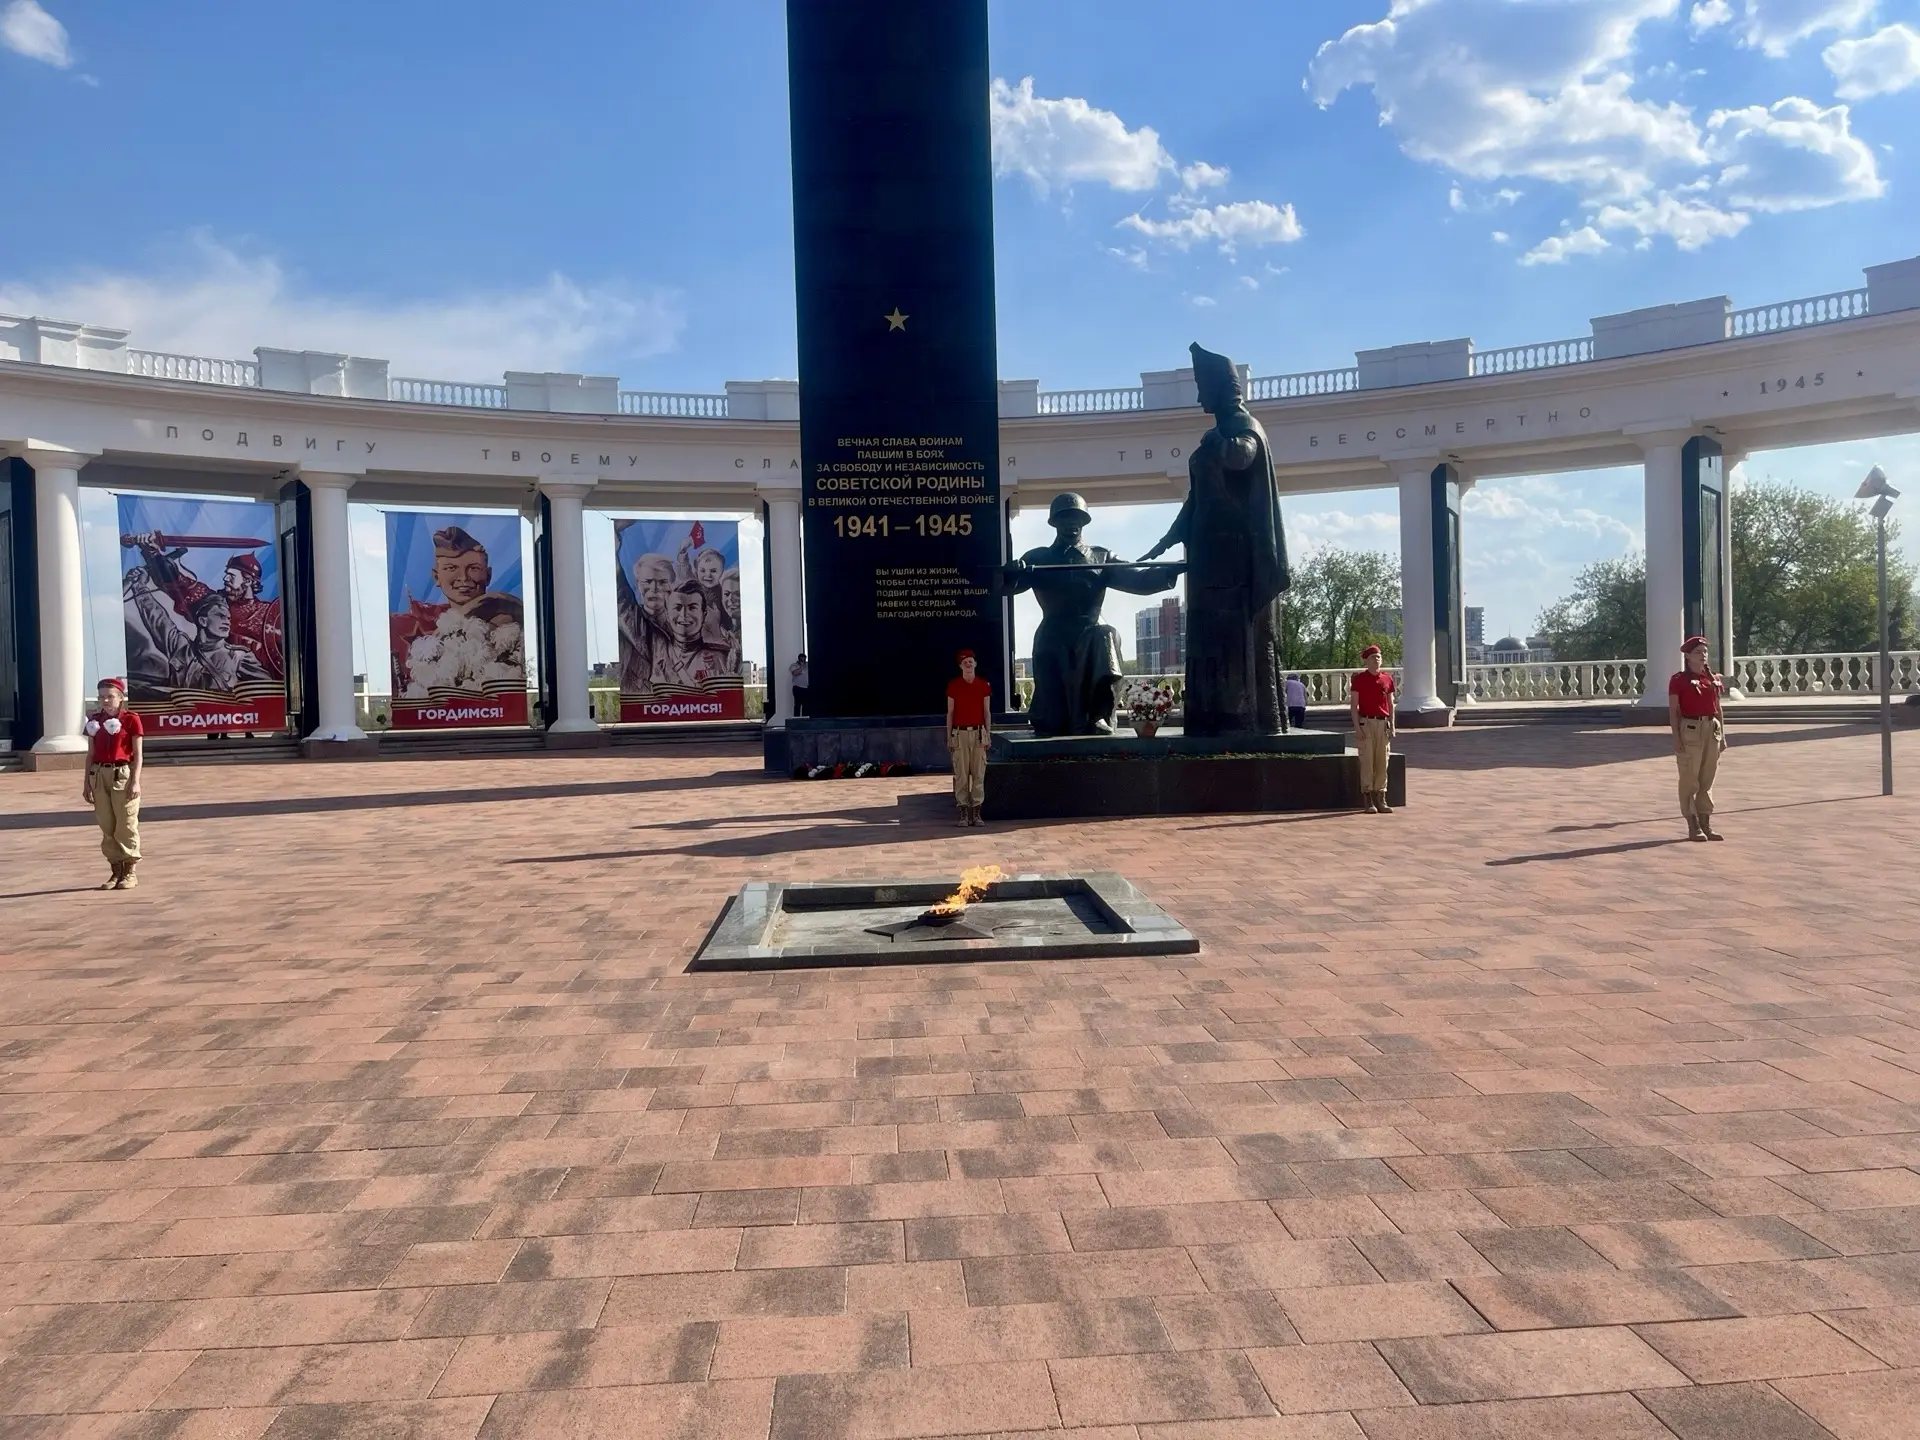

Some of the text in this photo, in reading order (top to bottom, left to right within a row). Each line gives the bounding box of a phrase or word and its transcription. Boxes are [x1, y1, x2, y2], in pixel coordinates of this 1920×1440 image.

[1759, 372, 1825, 395] 1945
[166, 407, 1591, 470] ПОДВИГУ ТВОЕМУ СЛА ТВО БЕССМЕРТНО
[837, 437, 963, 447] ВЕЧНАЯ СЛАВА ВОИНАМ
[857, 450, 944, 459] ПАВШИМ В БОЯХ
[816, 462, 985, 473] ЗА СВОБОДУ И НЕЗАВИСИМОСТЬ
[816, 475, 985, 491] СОВЕТСКОЙ РОДИНЫ
[808, 494, 995, 507] В ВЕЛИКОЙ ОТЕЧЕСТВЕННОЙ ВОЙНЕ
[875, 568, 889, 576] ВЫ
[891, 568, 915, 576] УШЛИ
[907, 578, 940, 586] СПАСТИ
[876, 590, 910, 598] ПОДВИГ
[933, 588, 962, 596] ИМЕНА
[876, 600, 910, 608] НАВЕКИ
[918, 599, 957, 608] СЕРДЦАХ
[876, 610, 942, 619] БЛАГОДАРНОГО
[417, 707, 504, 721] ГОРДИМСЯ!
[643, 702, 723, 716] ГОРДИМСЯ!
[159, 712, 259, 728] ГОРДИМСЯ!
